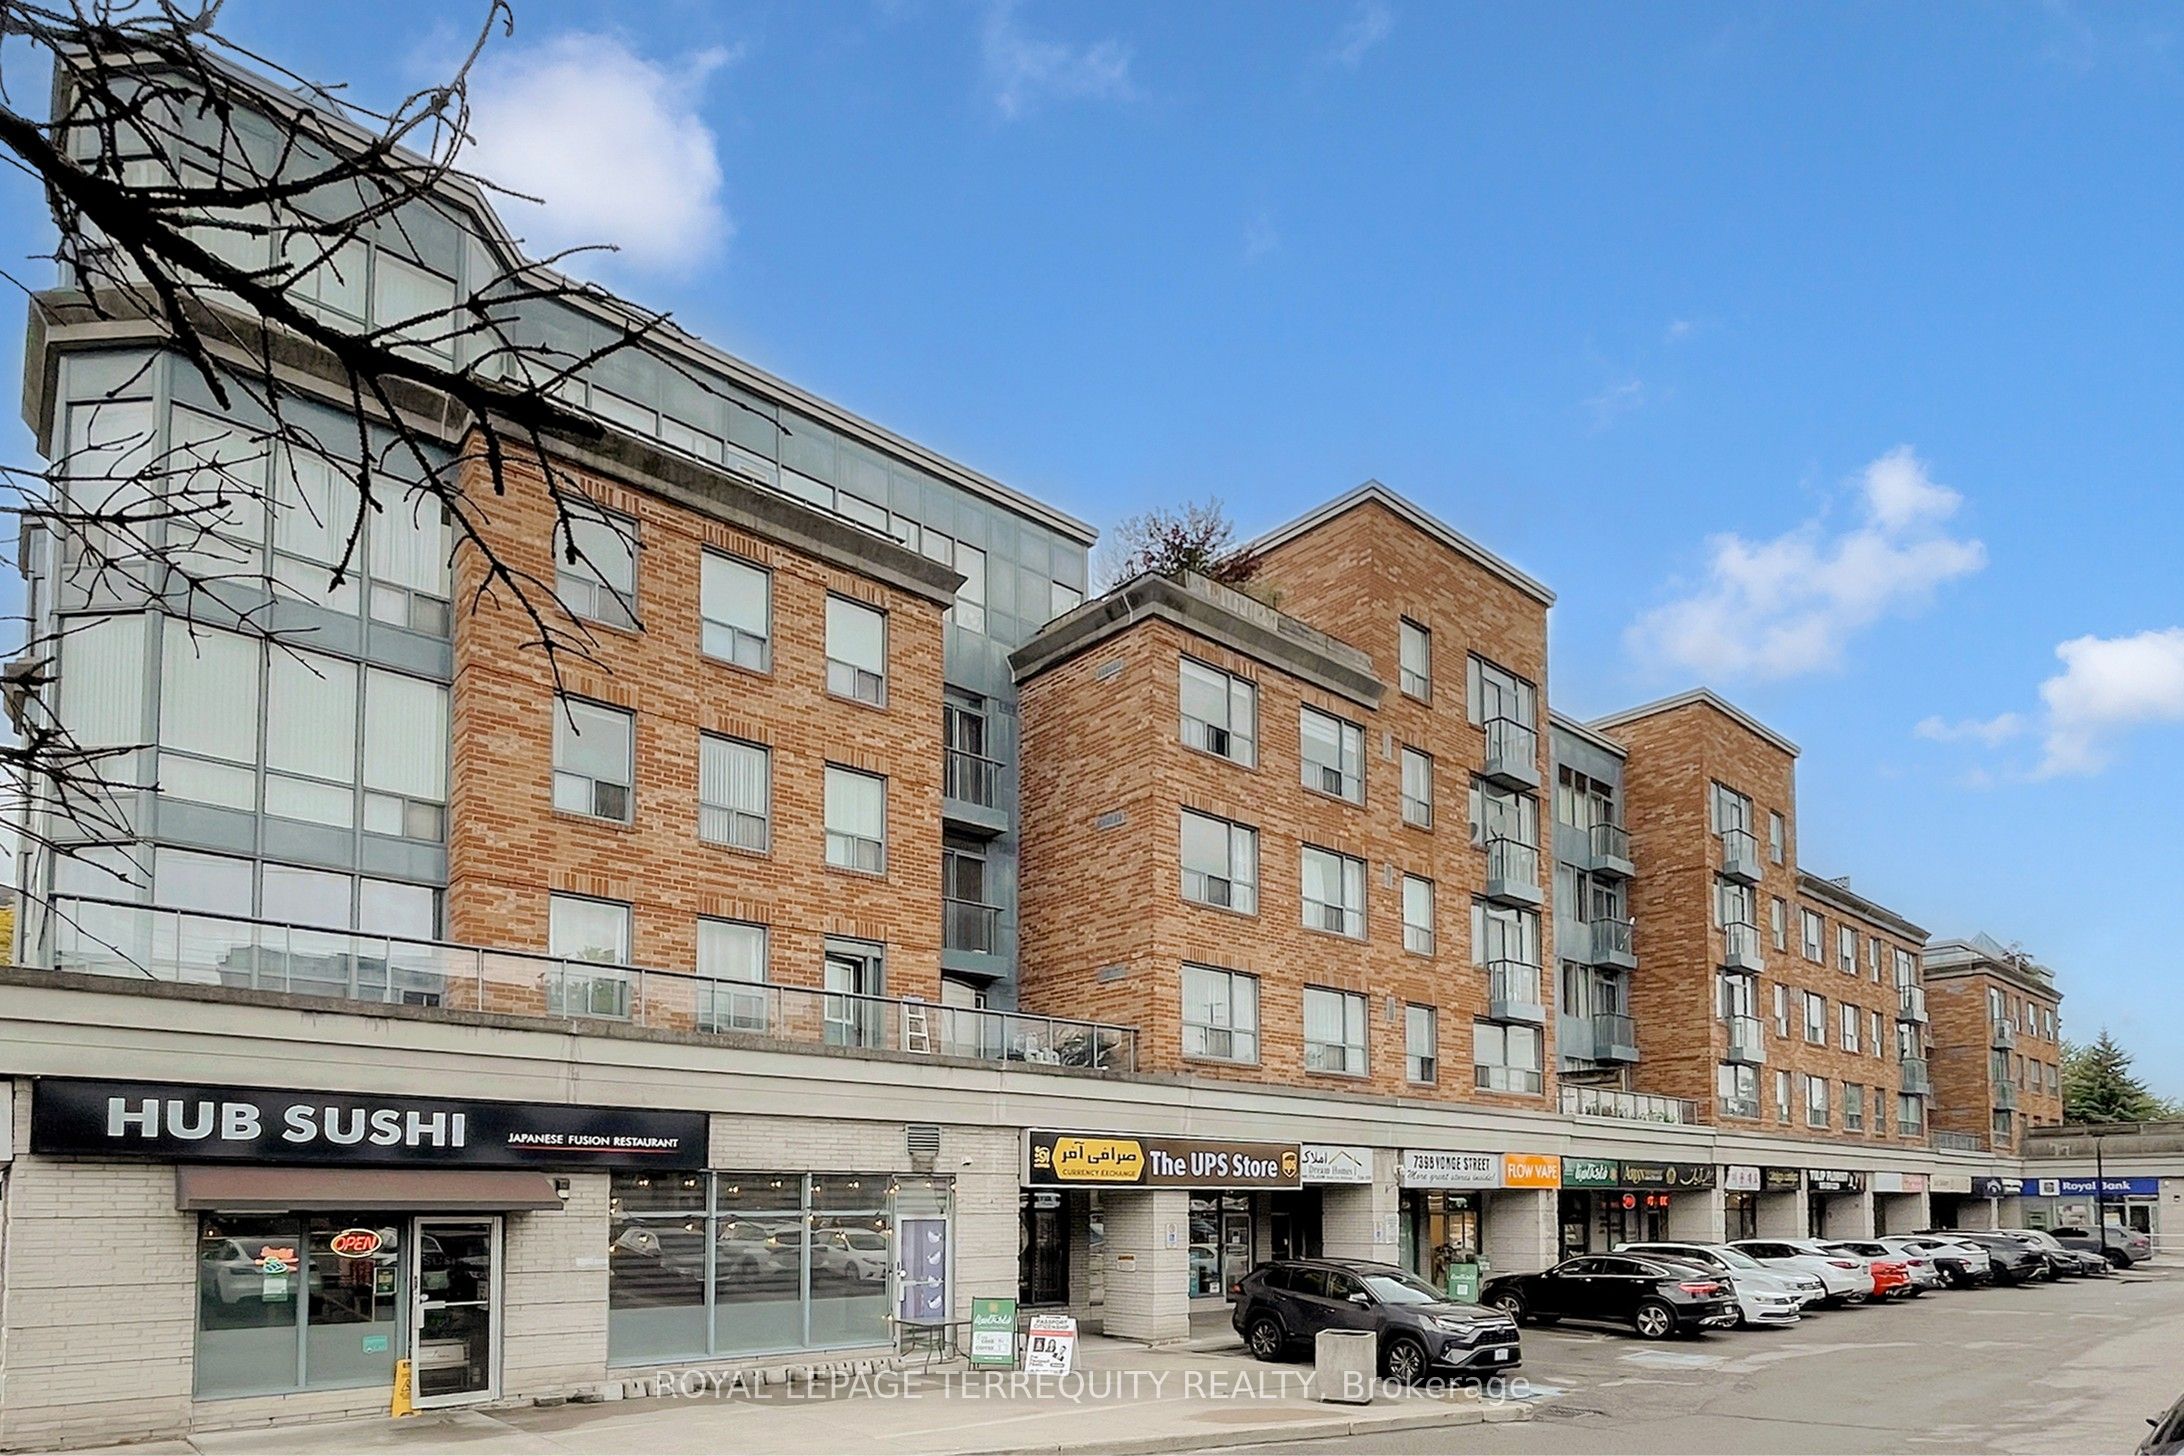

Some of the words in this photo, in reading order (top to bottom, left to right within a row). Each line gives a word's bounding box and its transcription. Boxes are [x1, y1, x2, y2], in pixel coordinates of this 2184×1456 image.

[106, 1097, 262, 1141] HUB
[281, 1104, 468, 1149] SUSHI
[508, 1132, 564, 1145] JAPANESE
[567, 1135, 611, 1146] FUSION
[613, 1136, 679, 1148] RESTAURANT
[1149, 1149, 1187, 1176] The
[1190, 1151, 1229, 1177] UPS
[1231, 1153, 1279, 1178] Store
[1435, 1156, 1461, 1171] YONGE
[1463, 1157, 1490, 1171] STREET
[1508, 1163, 1533, 1179] FLOW
[1534, 1164, 1558, 1180] VAPE
[1062, 1168, 1099, 1176] CURRENCY
[1101, 1169, 1136, 1177] EXCHANGE
[2062, 1181, 2096, 1192] Royal
[334, 1236, 377, 1252] OPEN
